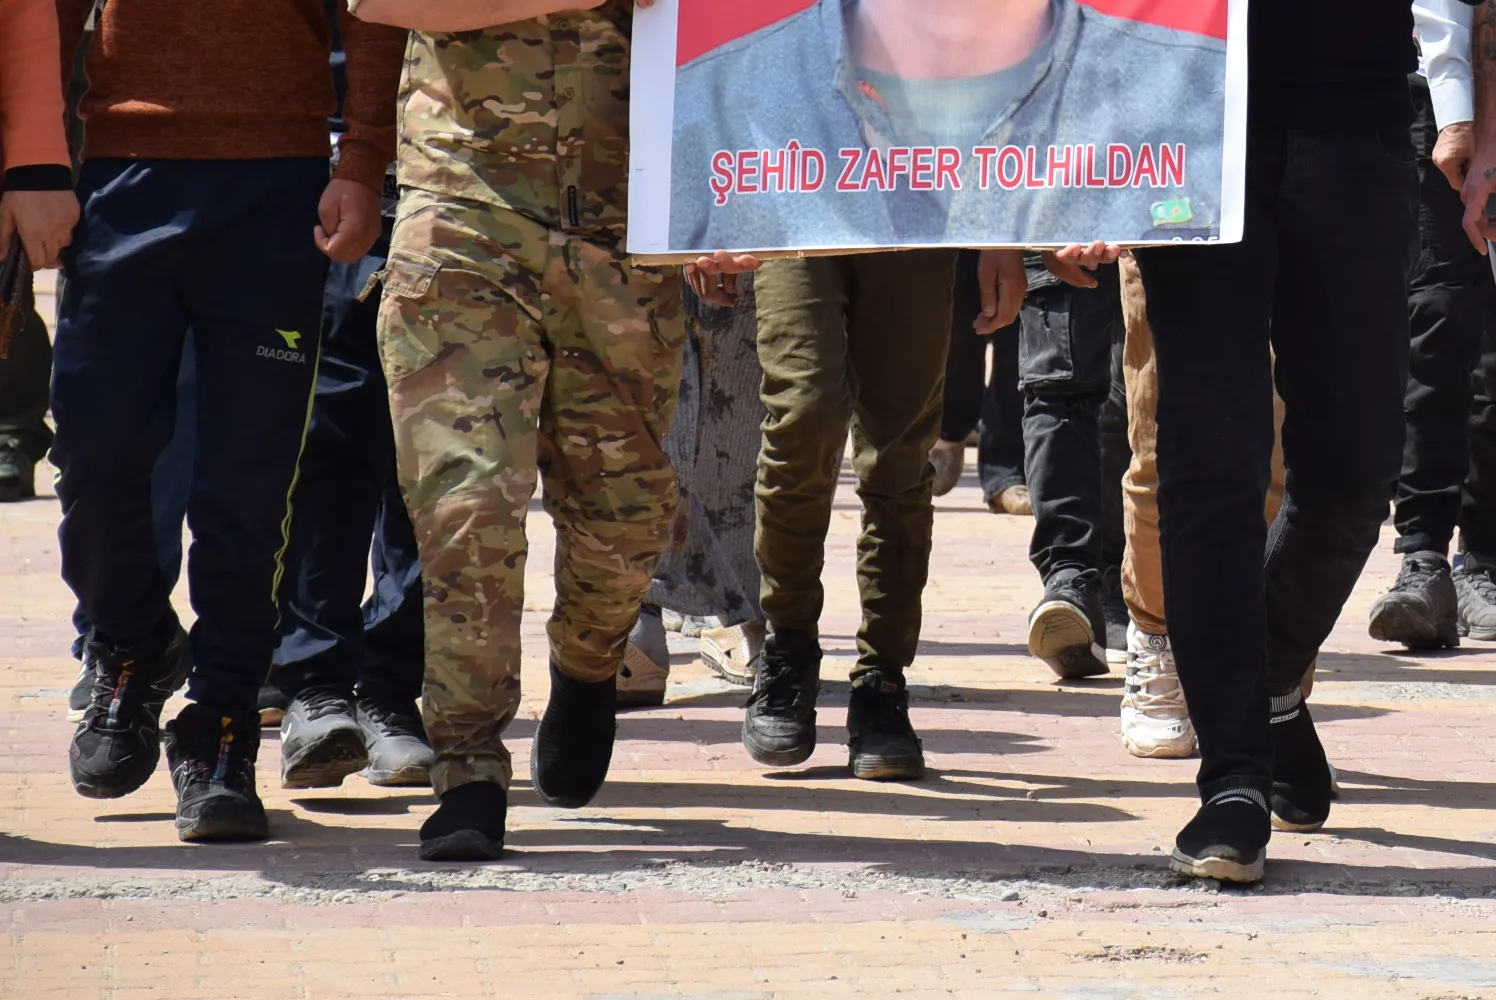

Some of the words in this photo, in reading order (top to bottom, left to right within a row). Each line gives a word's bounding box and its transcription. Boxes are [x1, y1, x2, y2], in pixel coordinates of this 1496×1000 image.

[708, 138, 827, 207] ŞEHÎD
[836, 145, 963, 192] ZAFER
[972, 142, 1186, 191] TOLHILDAN
[256, 345, 306, 364] DIADORA
